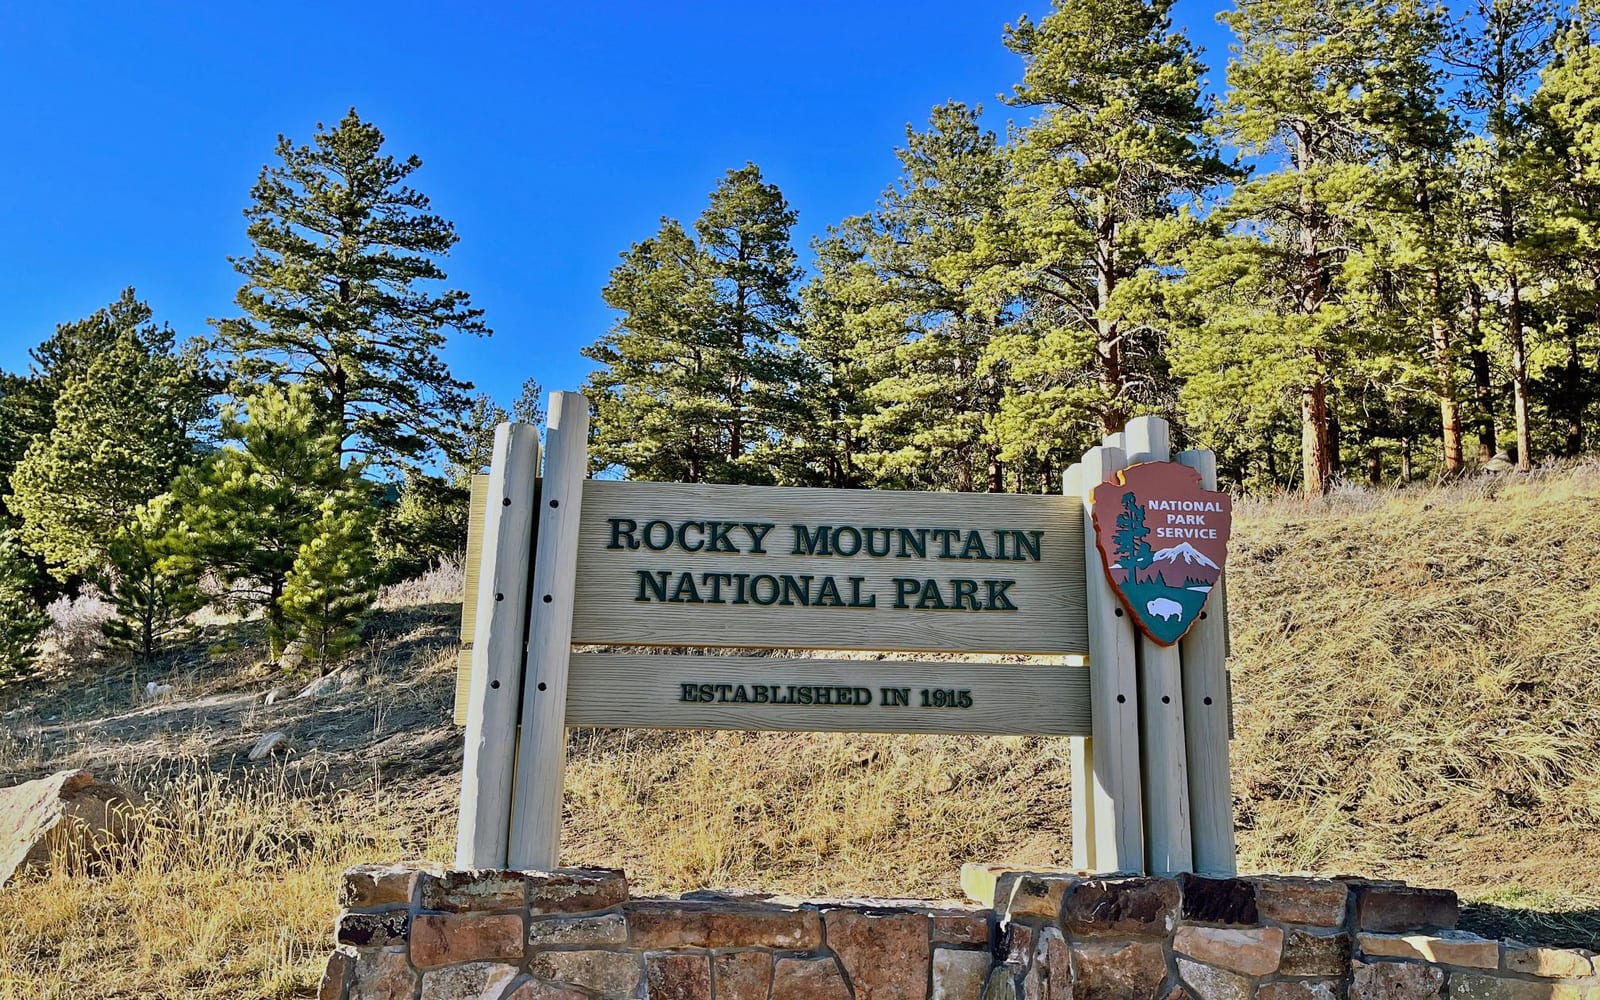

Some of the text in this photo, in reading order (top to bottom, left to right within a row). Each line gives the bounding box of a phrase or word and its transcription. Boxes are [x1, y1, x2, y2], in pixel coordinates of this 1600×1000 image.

[1148, 500, 1223, 512] NATIONAL
[1167, 514, 1205, 525] PARK
[606, 518, 1045, 562] ROCKY MOUNTAIN
[1156, 527, 1217, 540] SERVICE
[635, 570, 1019, 611] NATIONAL PARK
[680, 683, 973, 709] ESTABLISHED IN 1915
